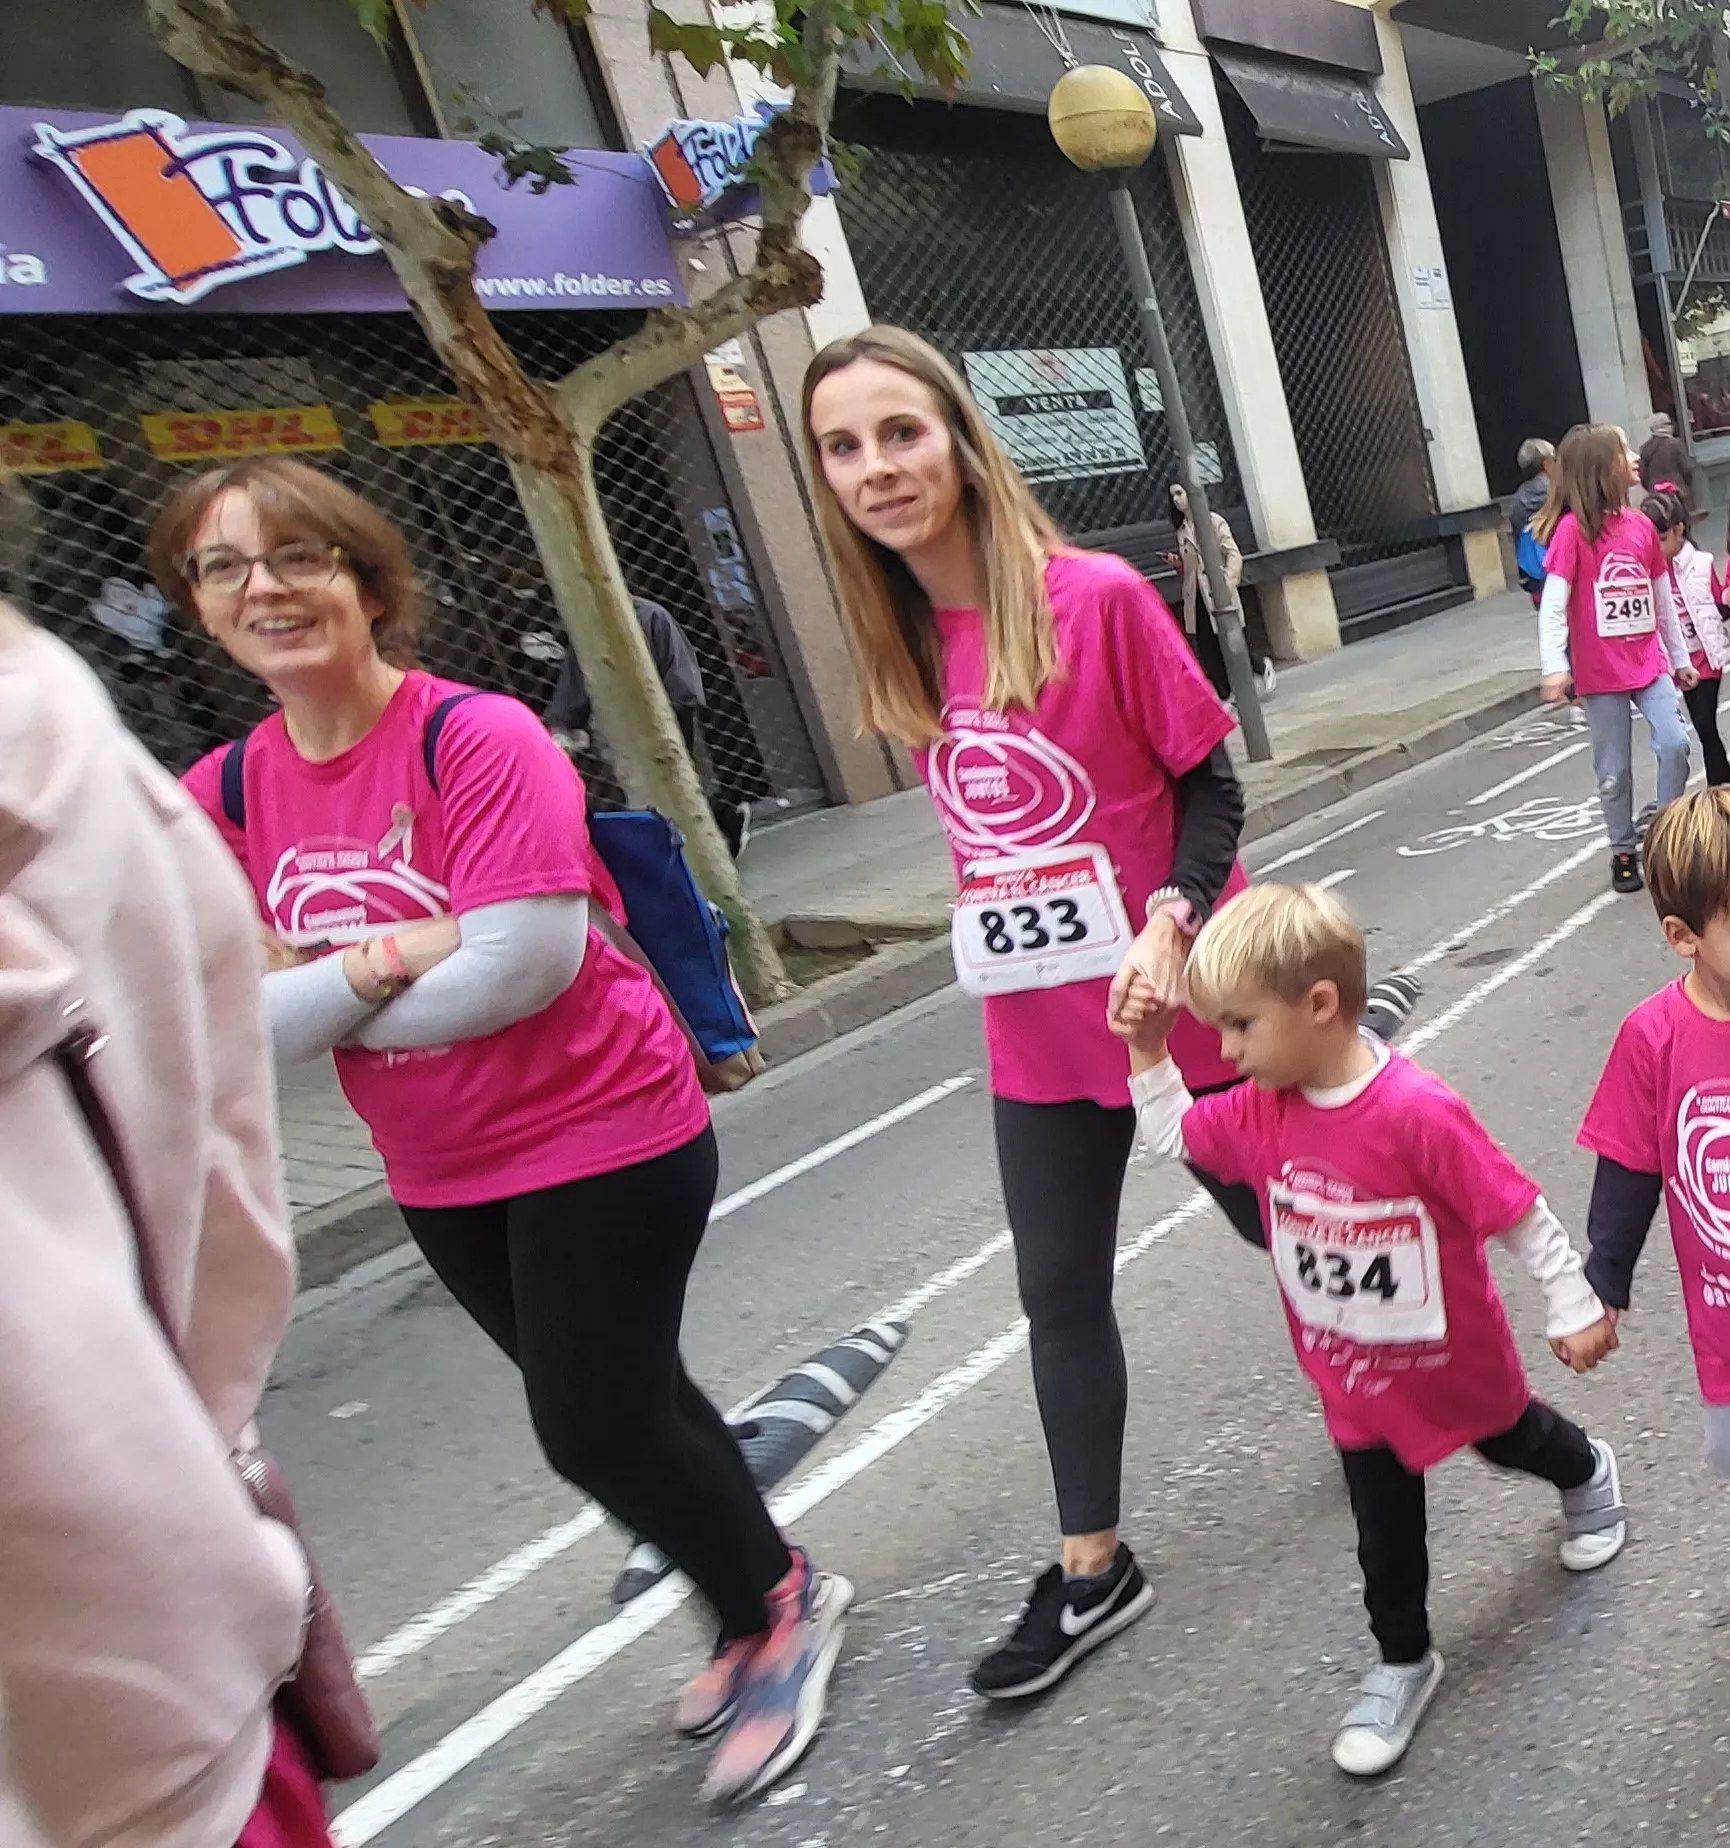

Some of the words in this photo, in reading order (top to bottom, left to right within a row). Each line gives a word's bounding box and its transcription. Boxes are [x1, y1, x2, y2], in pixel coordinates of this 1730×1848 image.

[474, 272, 674, 297] www.folder.es
[1604, 598, 1650, 621] 2491
[980, 898, 1088, 954] 833
[1296, 1243, 1399, 1306] 834
